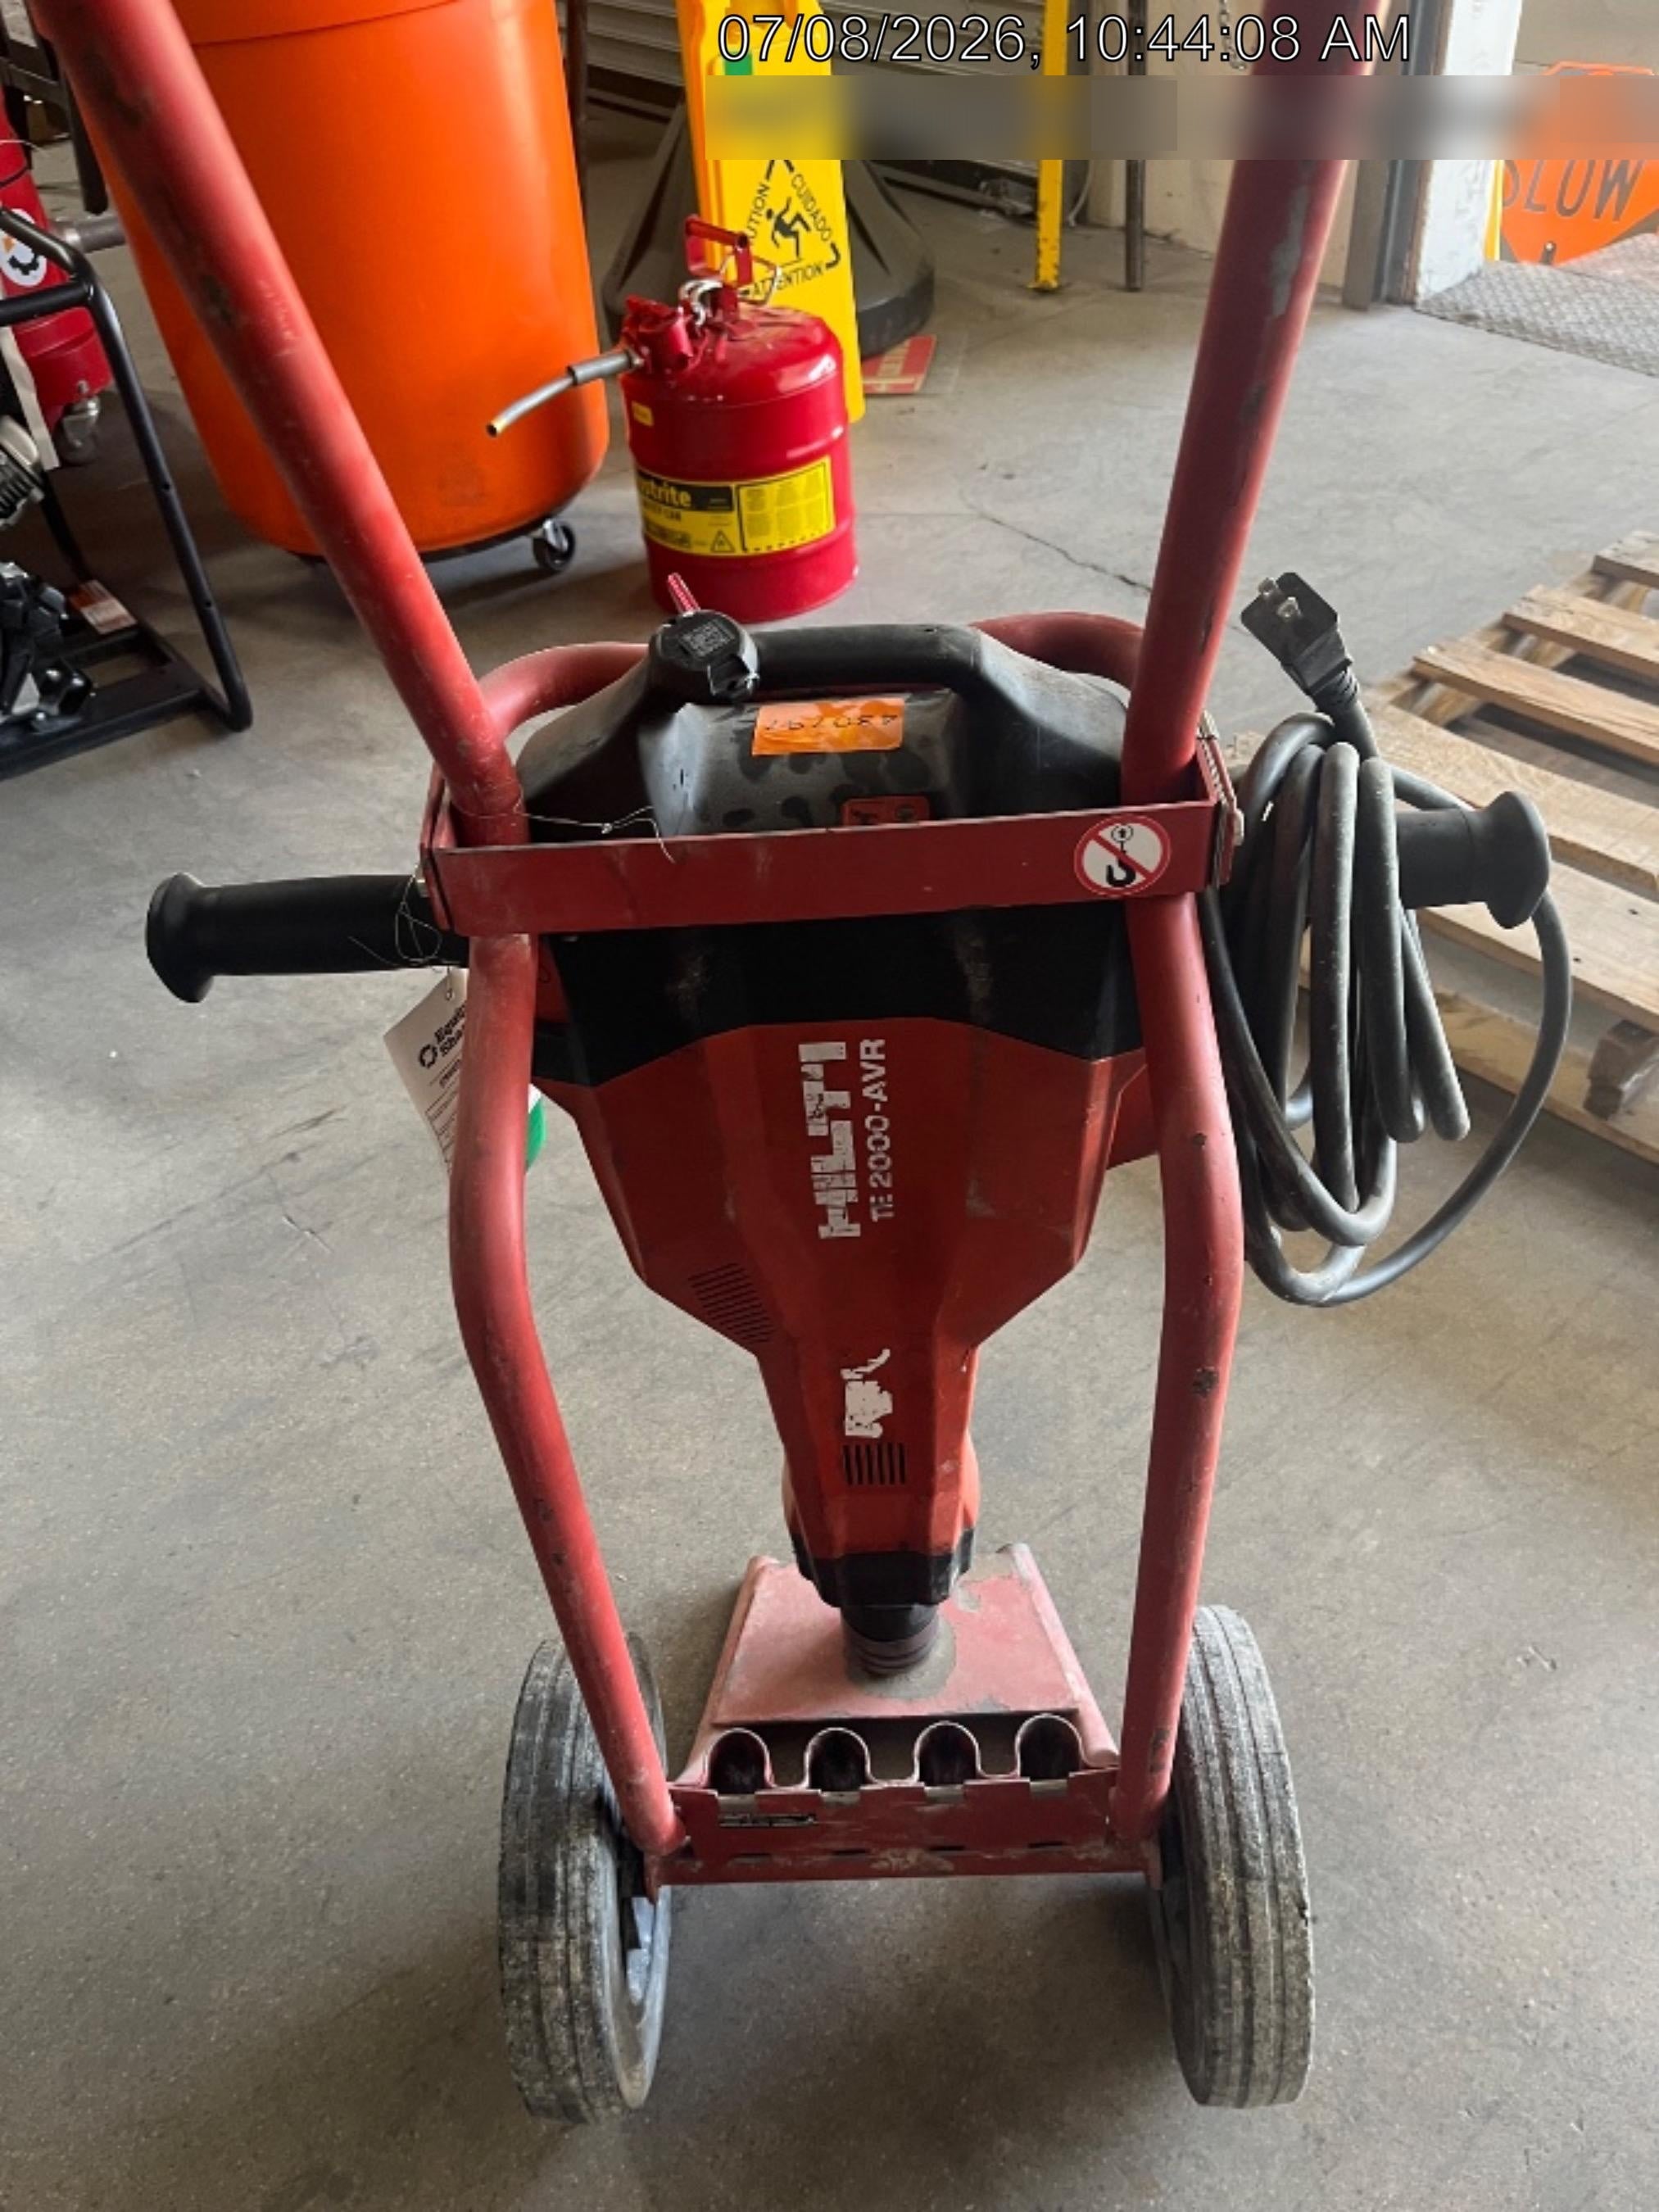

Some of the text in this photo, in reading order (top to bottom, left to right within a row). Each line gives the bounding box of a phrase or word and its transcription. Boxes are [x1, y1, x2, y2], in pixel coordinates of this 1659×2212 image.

[798, 1041, 861, 1240] HILTI
[859, 1038, 895, 1222] TE 2000-AVR
